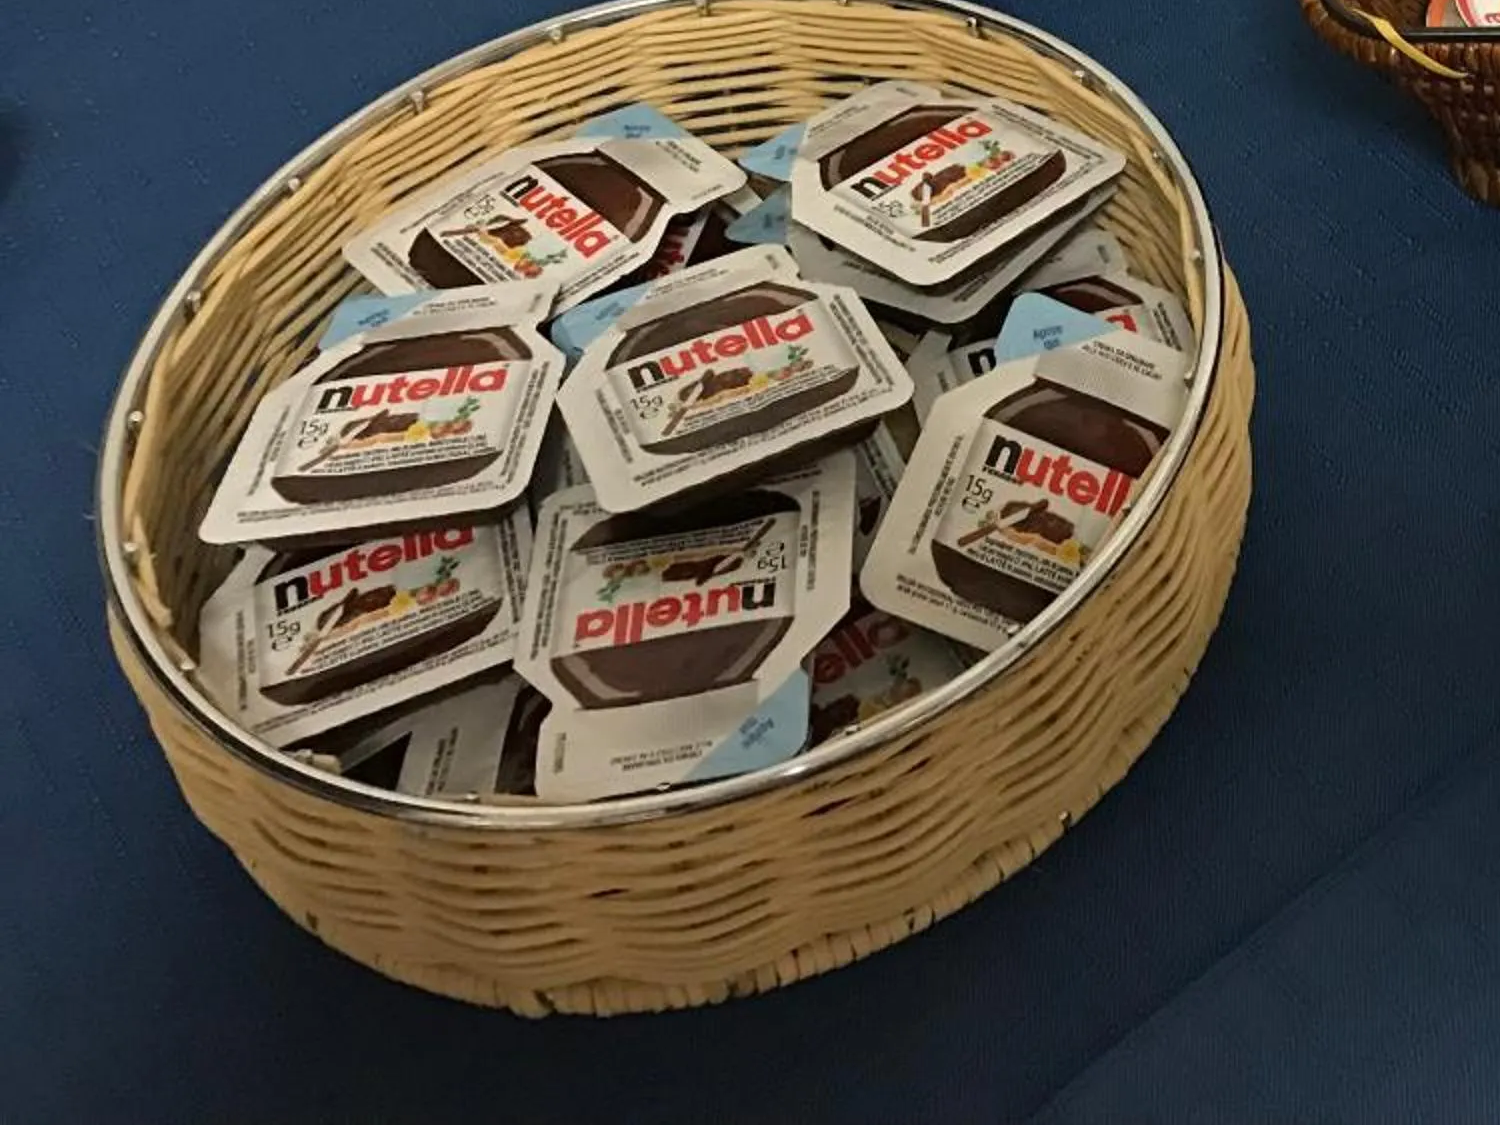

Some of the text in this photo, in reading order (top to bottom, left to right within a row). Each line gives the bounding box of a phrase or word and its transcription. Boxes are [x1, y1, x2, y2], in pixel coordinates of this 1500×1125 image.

[850, 116, 994, 200] nutella
[501, 174, 610, 259] nutella
[317, 364, 510, 411] nutella
[627, 312, 815, 389] nutella
[964, 474, 994, 504] 15g
[983, 433, 1132, 518] nutell
[273, 525, 475, 611] nutella
[267, 619, 301, 639] 15g
[574, 581, 777, 647] nutella
